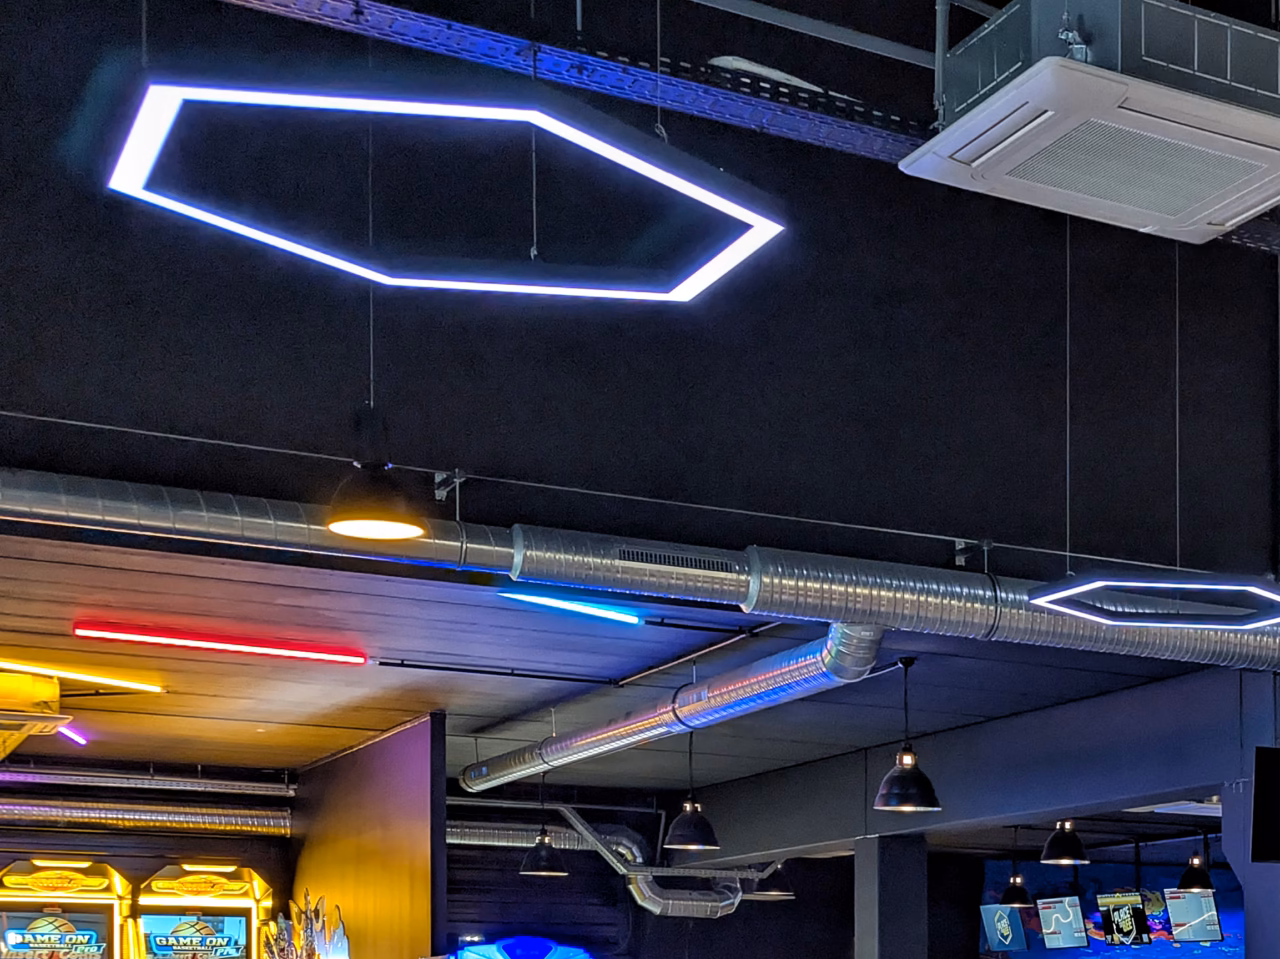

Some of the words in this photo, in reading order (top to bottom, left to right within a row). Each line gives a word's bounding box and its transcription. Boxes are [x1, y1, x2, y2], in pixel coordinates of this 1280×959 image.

[65, 934, 91, 944] ON
[155, 937, 203, 946] GAME
[206, 937, 230, 946] ON
